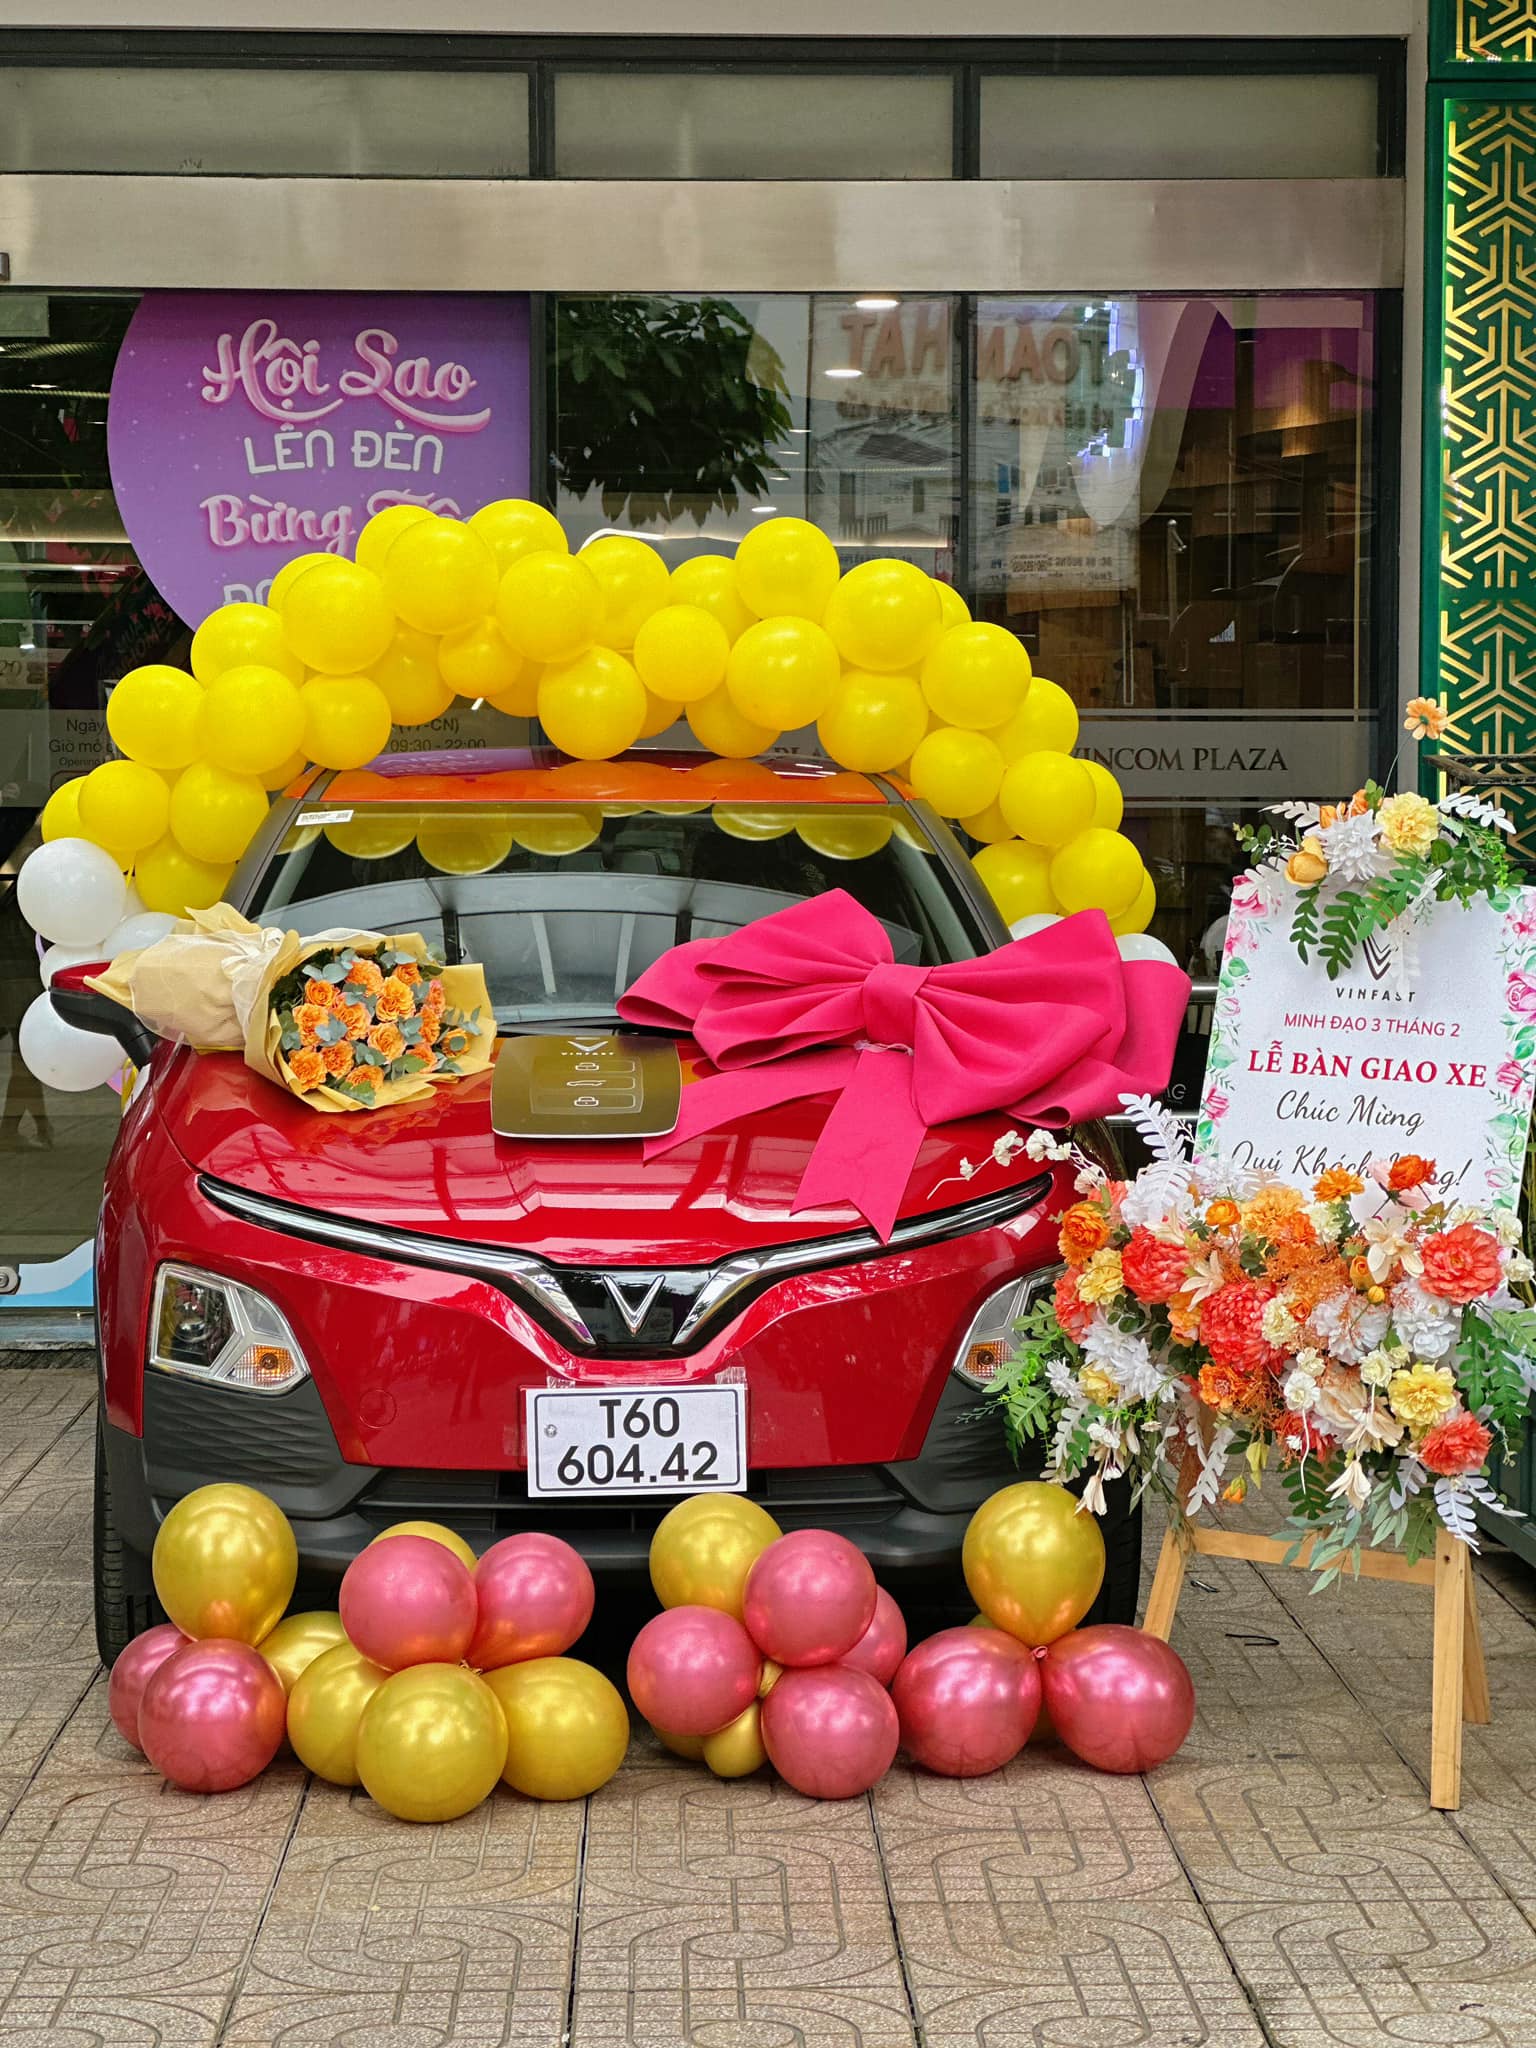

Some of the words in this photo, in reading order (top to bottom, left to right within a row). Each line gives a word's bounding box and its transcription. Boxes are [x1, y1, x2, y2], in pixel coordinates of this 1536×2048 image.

[202, 318, 343, 423] Hội
[339, 328, 491, 432] Sao
[351, 419, 443, 474] ĐÈN
[1192, 748, 1288, 771] PLAZA
[1284, 1013, 1326, 1029] MINH
[1330, 1015, 1367, 1033] ĐẠO
[1371, 1018, 1381, 1032] 3
[1386, 1017, 1445, 1037] THÁNG
[1450, 1023, 1460, 1038] 2
[1248, 1040, 1283, 1073] LỄ
[1290, 1047, 1352, 1078] BÀN
[1360, 1057, 1438, 1084] GIAO
[1446, 1063, 1487, 1088] XE
[1276, 1089, 1340, 1123] Chúc
[1346, 1094, 1425, 1137] Mừng
[599, 1397, 680, 1439] T60
[557, 1441, 719, 1486] 604.42
